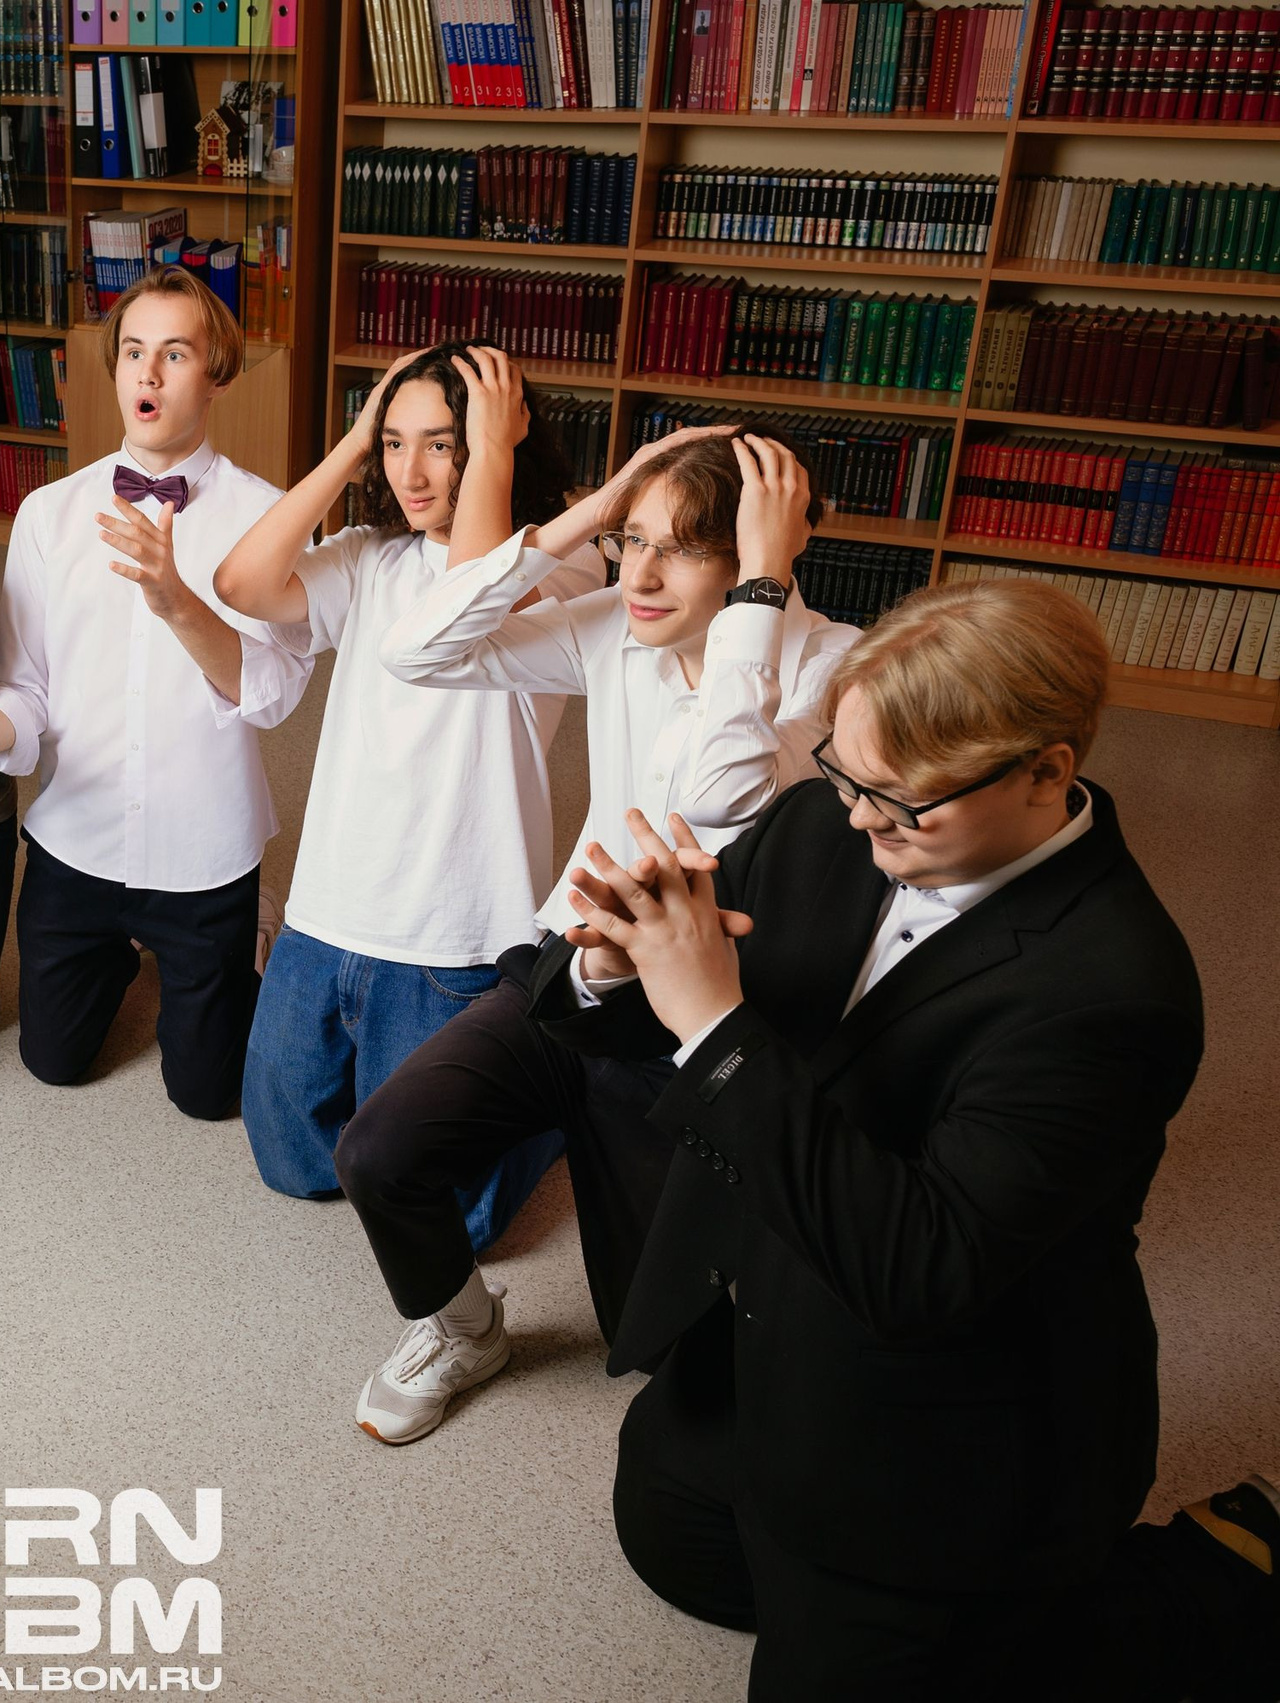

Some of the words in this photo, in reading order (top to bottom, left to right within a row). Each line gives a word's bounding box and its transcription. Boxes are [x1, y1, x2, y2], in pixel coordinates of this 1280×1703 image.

[454, 84, 458, 94] 1
[464, 86, 470, 96] 2
[477, 85, 482, 95] 3
[485, 86, 489, 95] 1
[496, 86, 501, 96] 2
[506, 87, 512, 97] 3
[516, 88, 522, 97] 3
[164, 214, 183, 233] 2020
[718, 1054, 744, 1079] DIGEL
